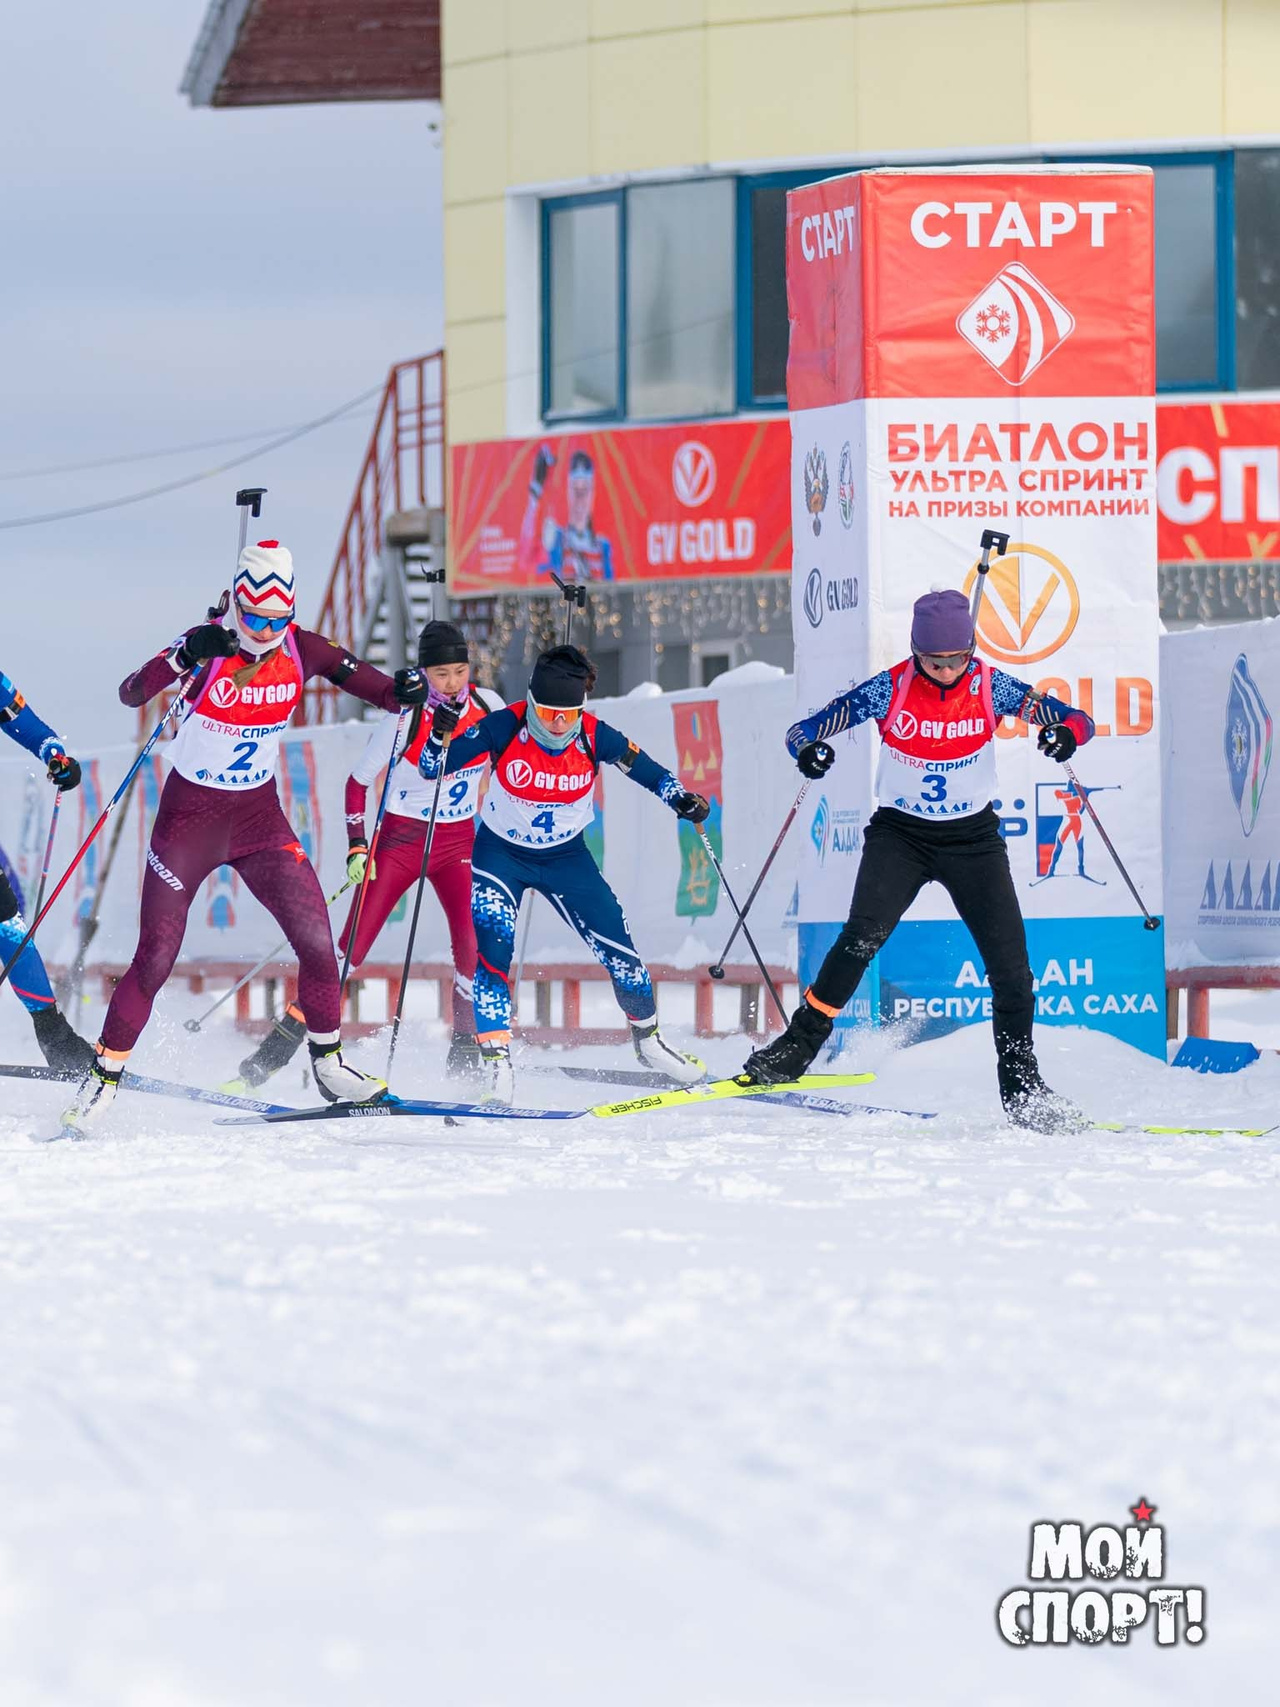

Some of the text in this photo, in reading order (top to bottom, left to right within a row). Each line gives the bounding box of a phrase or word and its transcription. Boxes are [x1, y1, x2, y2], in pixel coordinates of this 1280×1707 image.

[801, 206, 855, 262] СТАРТ
[910, 201, 1117, 248] СТАРТ
[887, 422, 1149, 463] БИАТЛОН
[891, 468, 1149, 493] УЛЬТРА СПРИНТ
[889, 499, 1150, 518] НА ПРИЗЫ КОМПАНИИ
[647, 518, 756, 565] GV GOLD
[827, 577, 858, 612] GV GOLD
[241, 686, 264, 705] GV
[920, 718, 985, 740] GV GOLD
[226, 741, 259, 771] 2
[890, 749, 980, 772] ULTRAСПРИНТ
[449, 780, 469, 806] 9
[534, 771, 556, 790] GV
[920, 774, 948, 802] 3
[400, 790, 407, 800] 9
[531, 811, 555, 834] 4
[955, 958, 1093, 992] ААН
[894, 993, 1159, 1019] РЕСПУКА САХА
[212, 1093, 270, 1113] SALOMON
[348, 1106, 391, 1117] SALOMON
[610, 1096, 663, 1114] FISCHER
